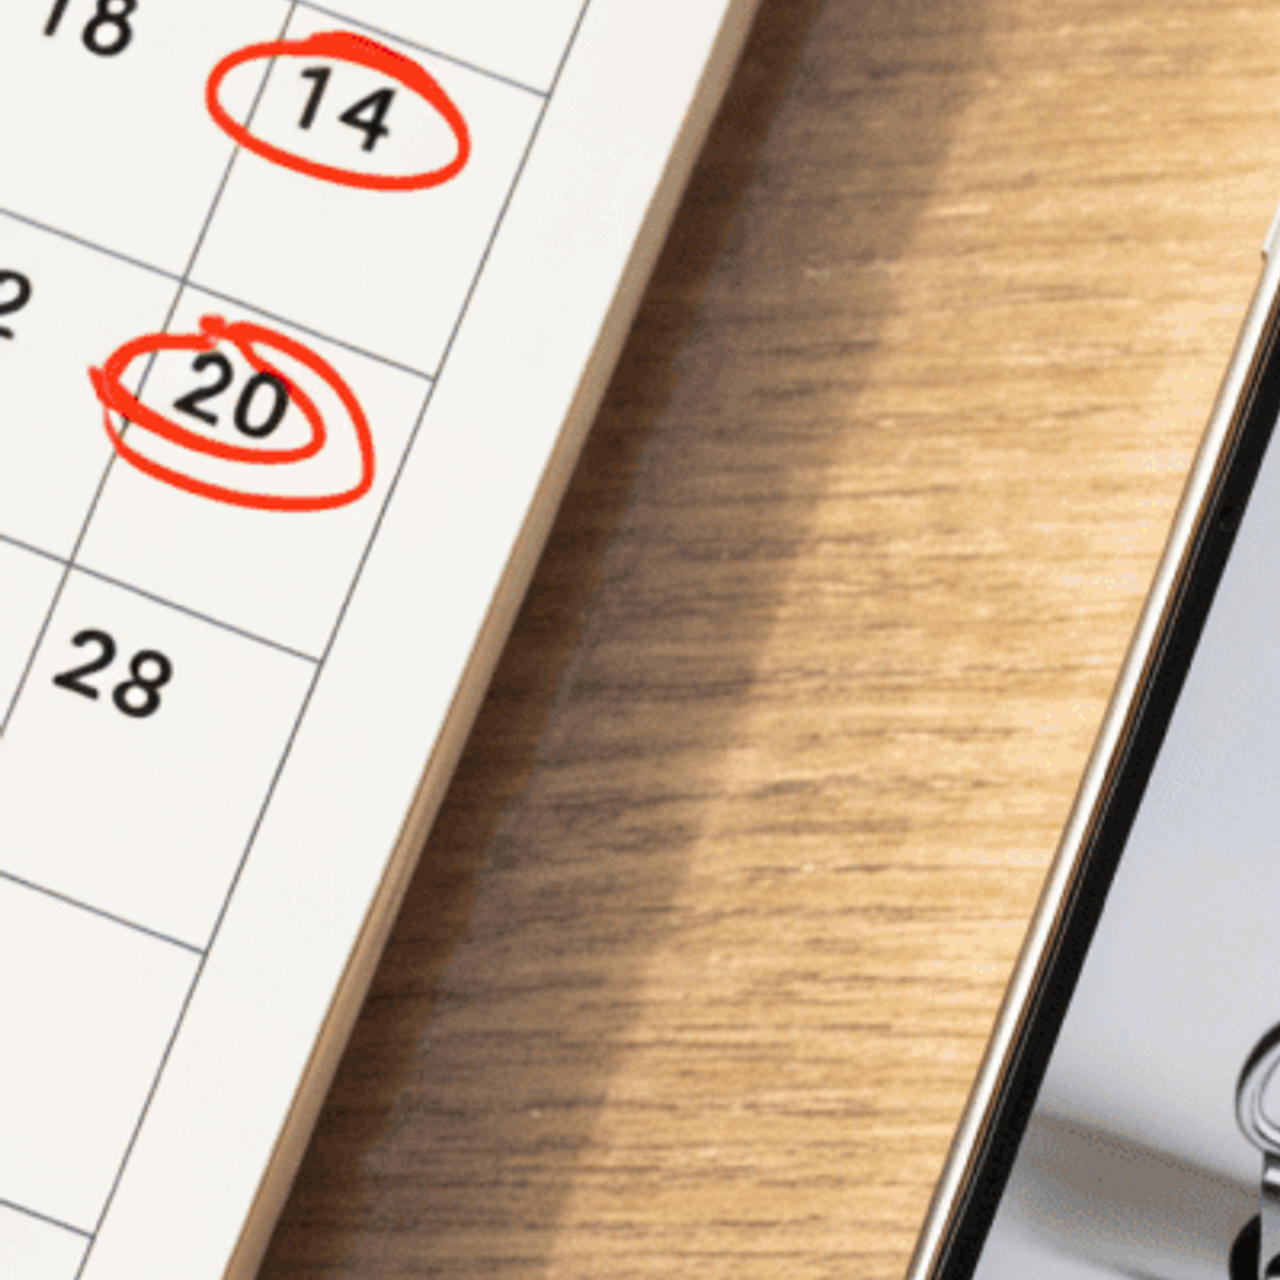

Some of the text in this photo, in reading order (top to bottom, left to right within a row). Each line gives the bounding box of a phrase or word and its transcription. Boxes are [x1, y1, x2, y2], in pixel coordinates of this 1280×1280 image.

[298, 66, 396, 153] 14
[172, 351, 290, 439] 20
[52, 629, 174, 719] 28
